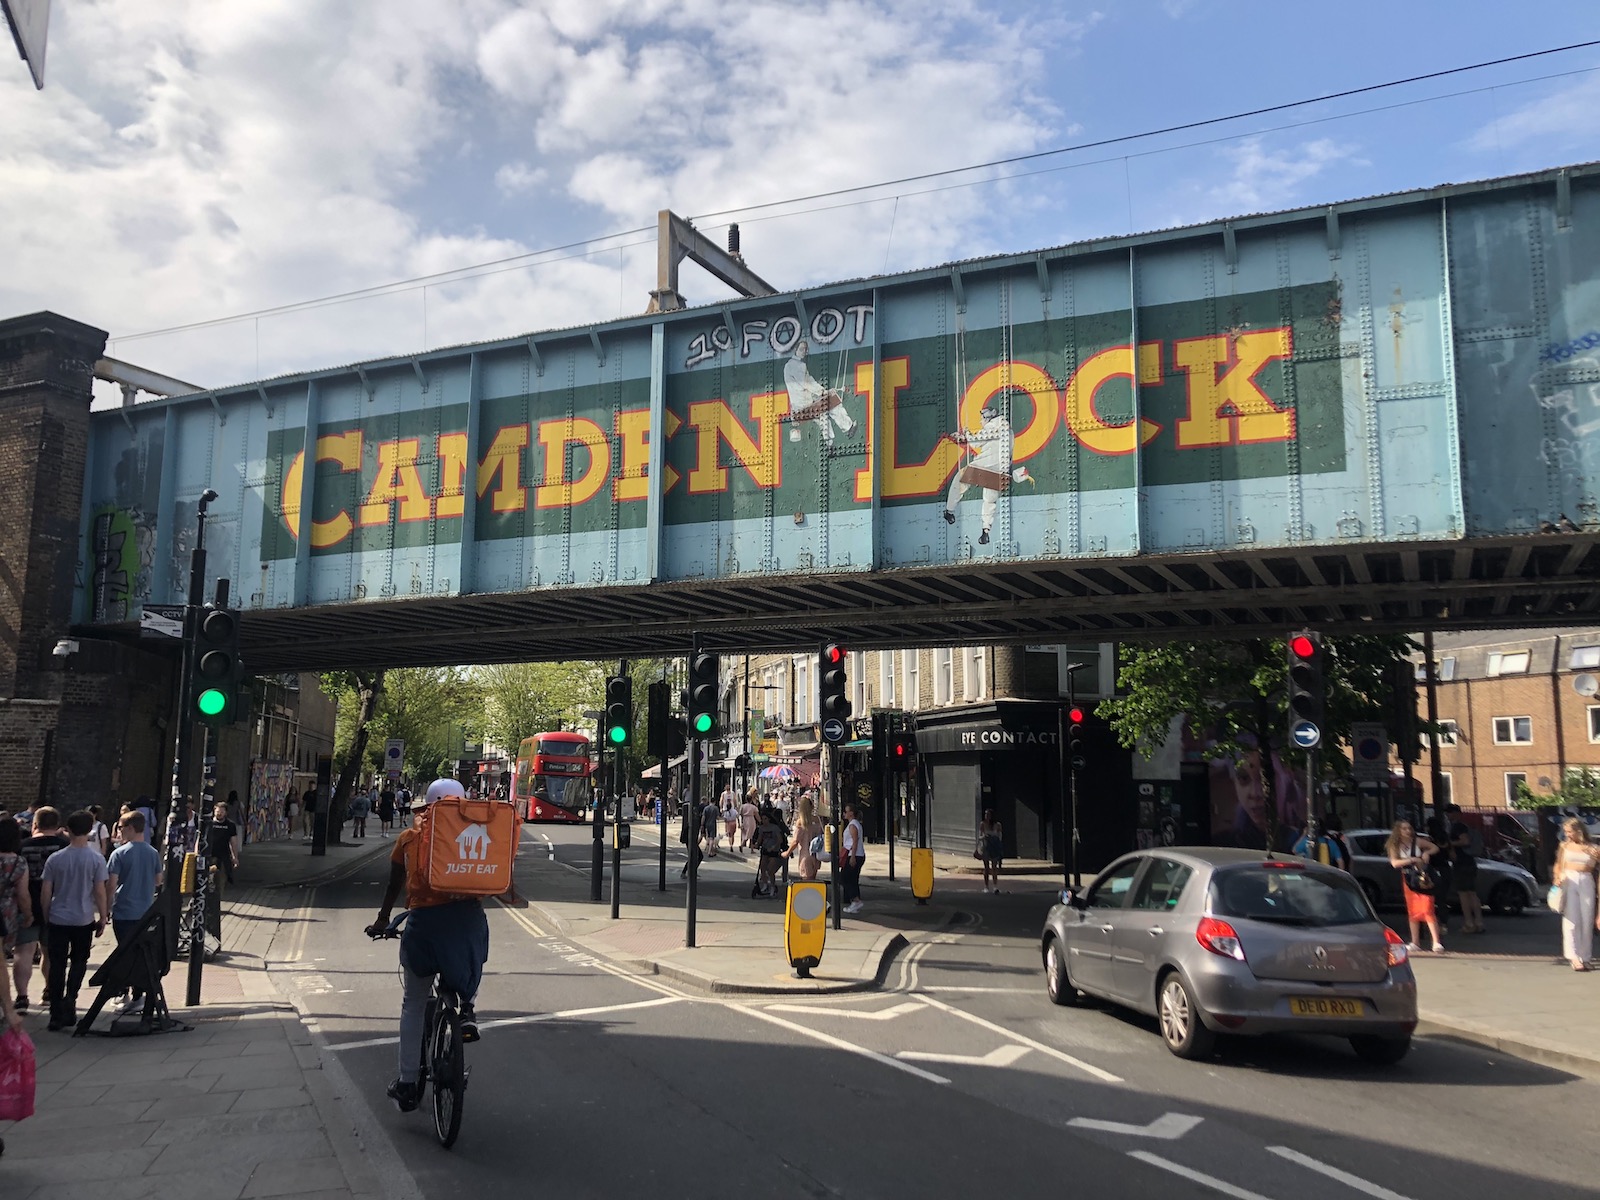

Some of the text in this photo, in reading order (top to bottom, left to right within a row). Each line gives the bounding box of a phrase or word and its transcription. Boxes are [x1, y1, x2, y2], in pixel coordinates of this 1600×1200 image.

[281, 325, 1297, 549] CAMDEN LOCK
[962, 731, 1057, 744] EYE CONTACT
[572, 763, 581, 771] 24
[445, 863, 498, 875] JUST EAT
